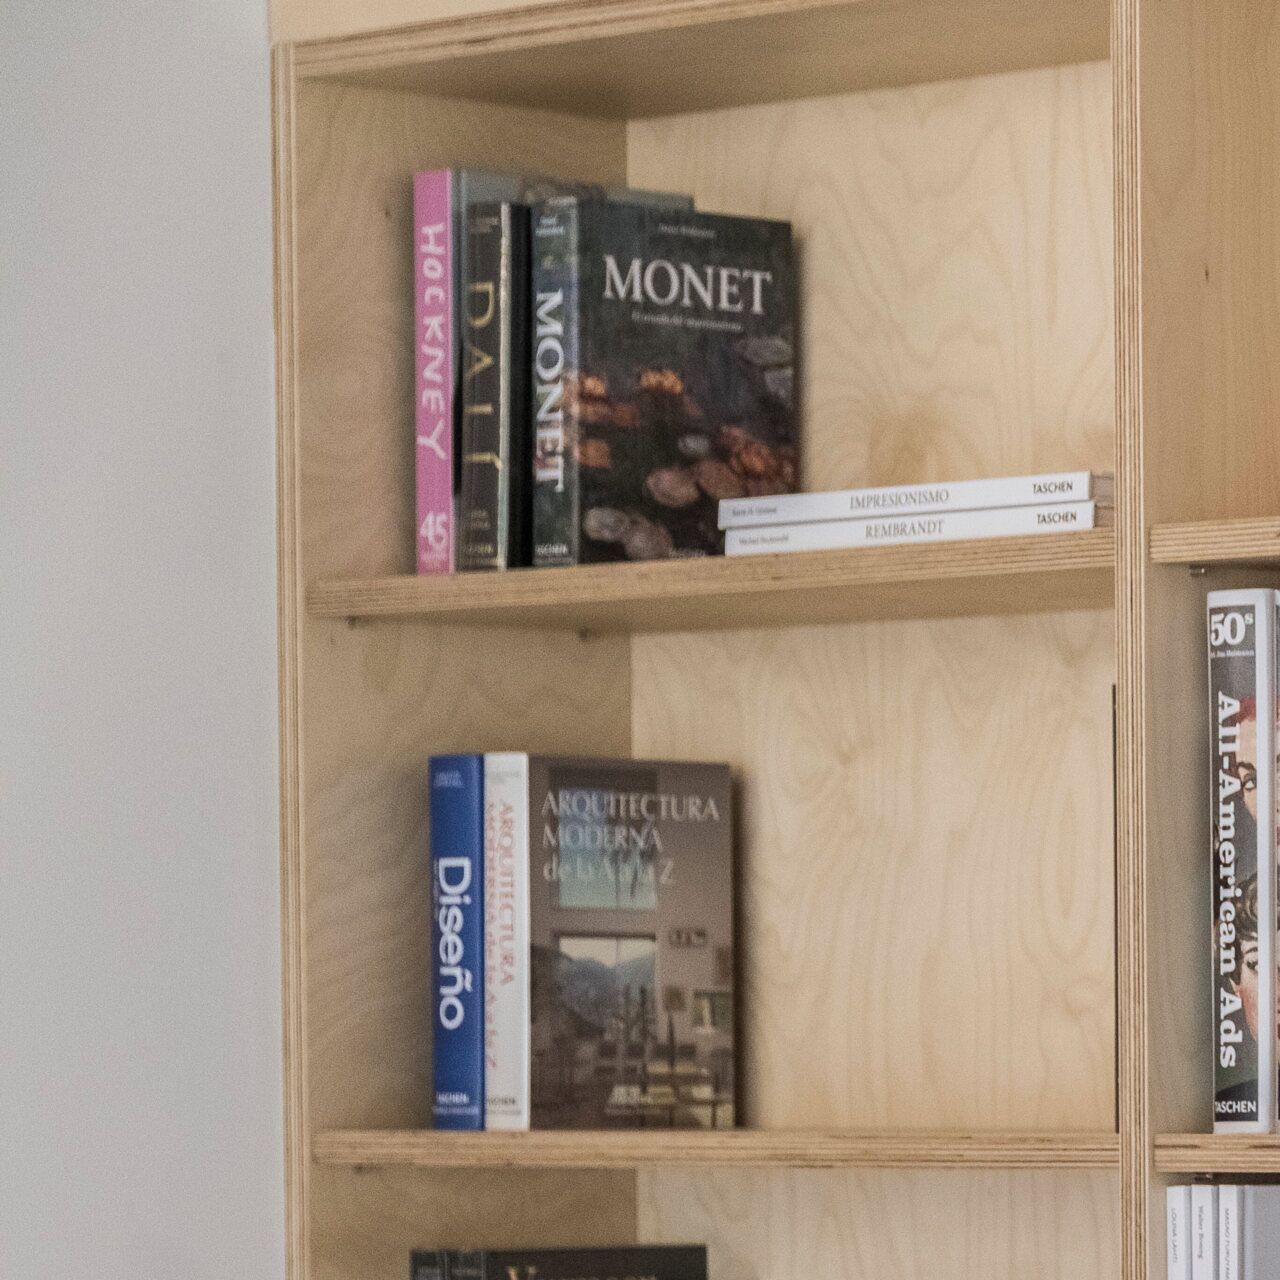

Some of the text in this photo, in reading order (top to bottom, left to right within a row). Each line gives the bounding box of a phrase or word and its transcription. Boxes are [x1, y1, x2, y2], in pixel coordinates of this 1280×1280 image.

[602, 253, 774, 316] MONET
[417, 222, 448, 460] HOCKNEY
[536, 288, 565, 493] MONET
[849, 488, 950, 511] IMPRESIONISMO
[1032, 480, 1073, 495] TASCHEN
[420, 511, 448, 550] 45
[865, 519, 945, 539] REMBRANDT
[1037, 511, 1077, 525] TASCHEN
[541, 790, 720, 823] ARQUITECTURA
[498, 801, 515, 986] ARQUITECTURA
[1218, 690, 1243, 1069] All-American Ads
[437, 856, 473, 1030] Diseño
